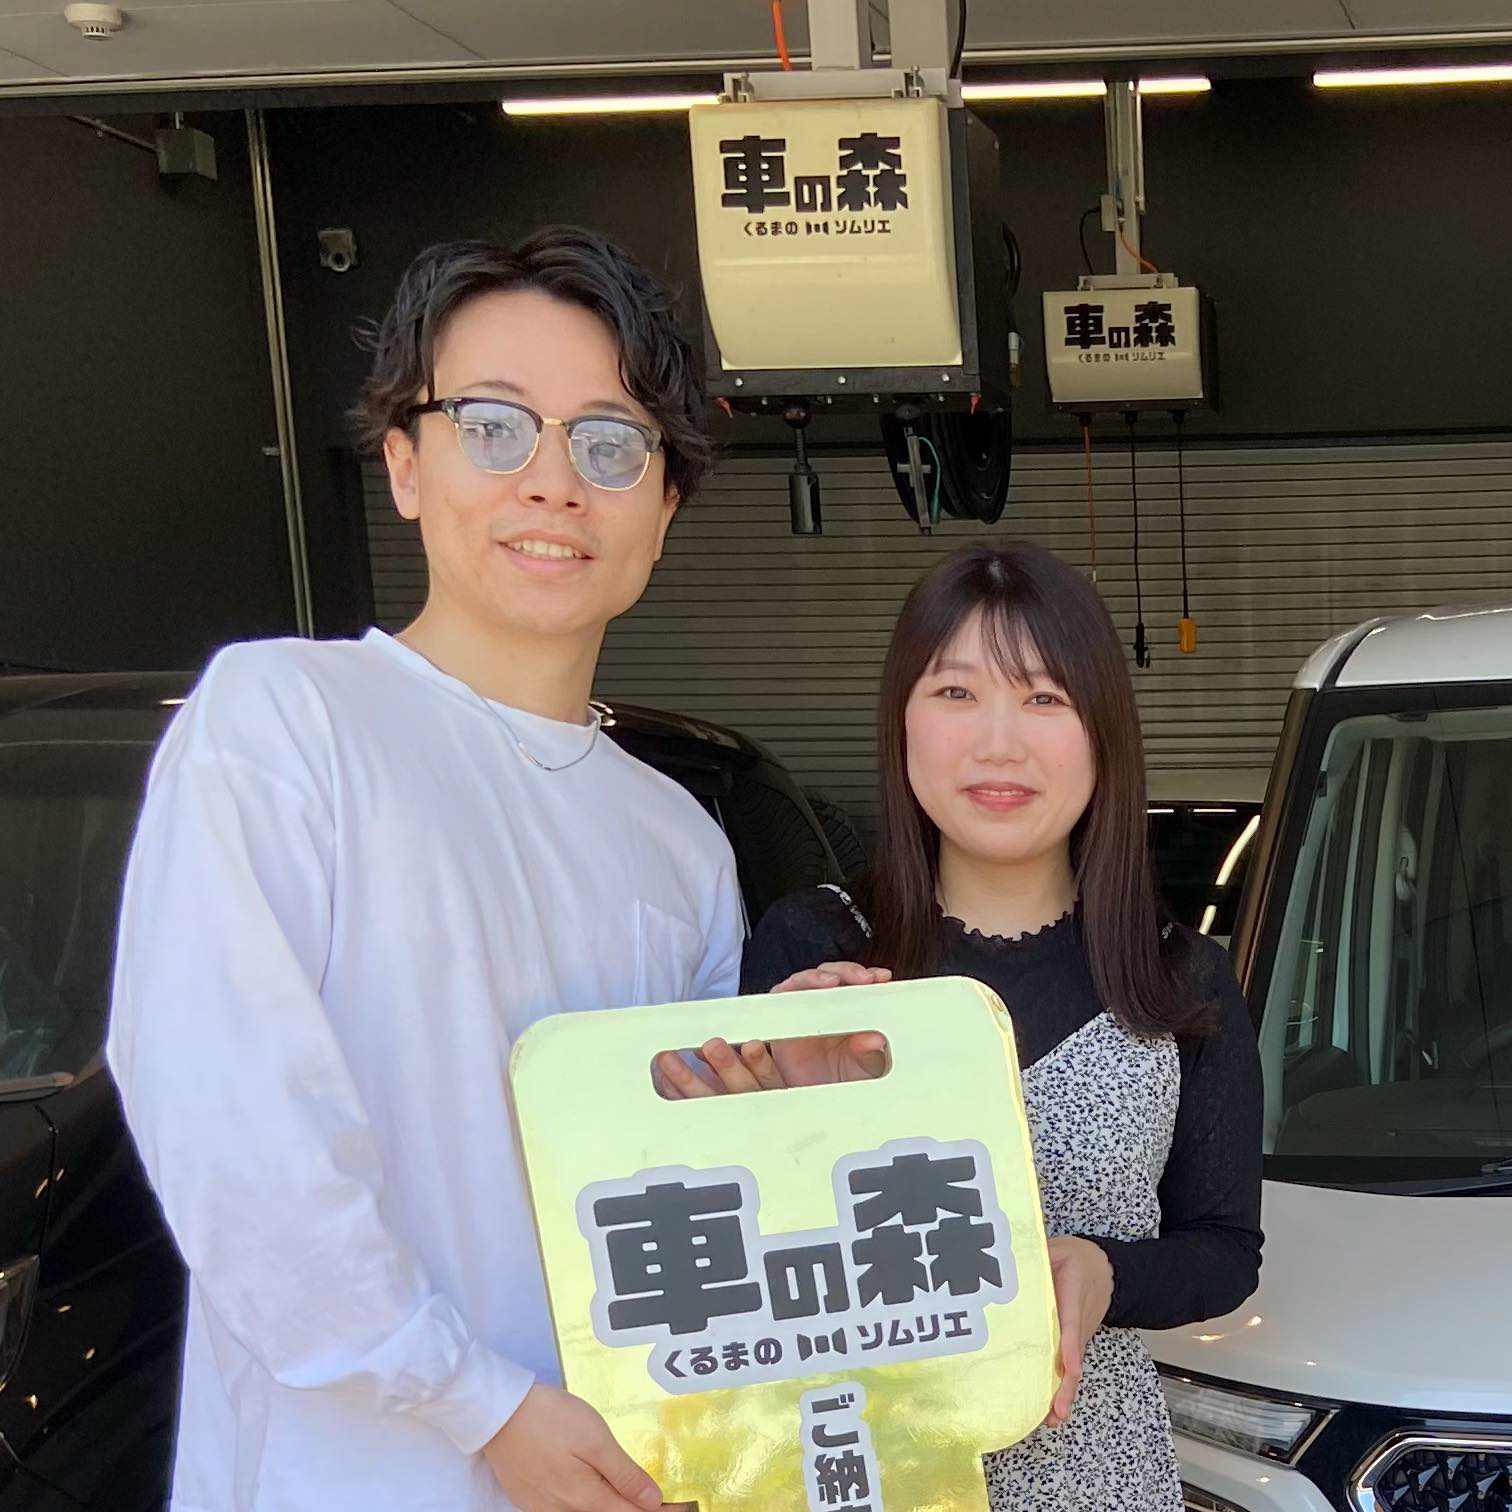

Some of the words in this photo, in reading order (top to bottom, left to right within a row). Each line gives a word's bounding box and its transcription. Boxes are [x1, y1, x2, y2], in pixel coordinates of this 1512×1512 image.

[718, 132, 908, 213] 車の森
[743, 221, 799, 236] くるまの
[834, 219, 892, 235] ソムリエ
[1063, 300, 1177, 349] 車の森
[593, 1152, 1003, 1335] 車の森
[664, 1336, 784, 1378] くるまの
[856, 1310, 972, 1351] ソムリエ
